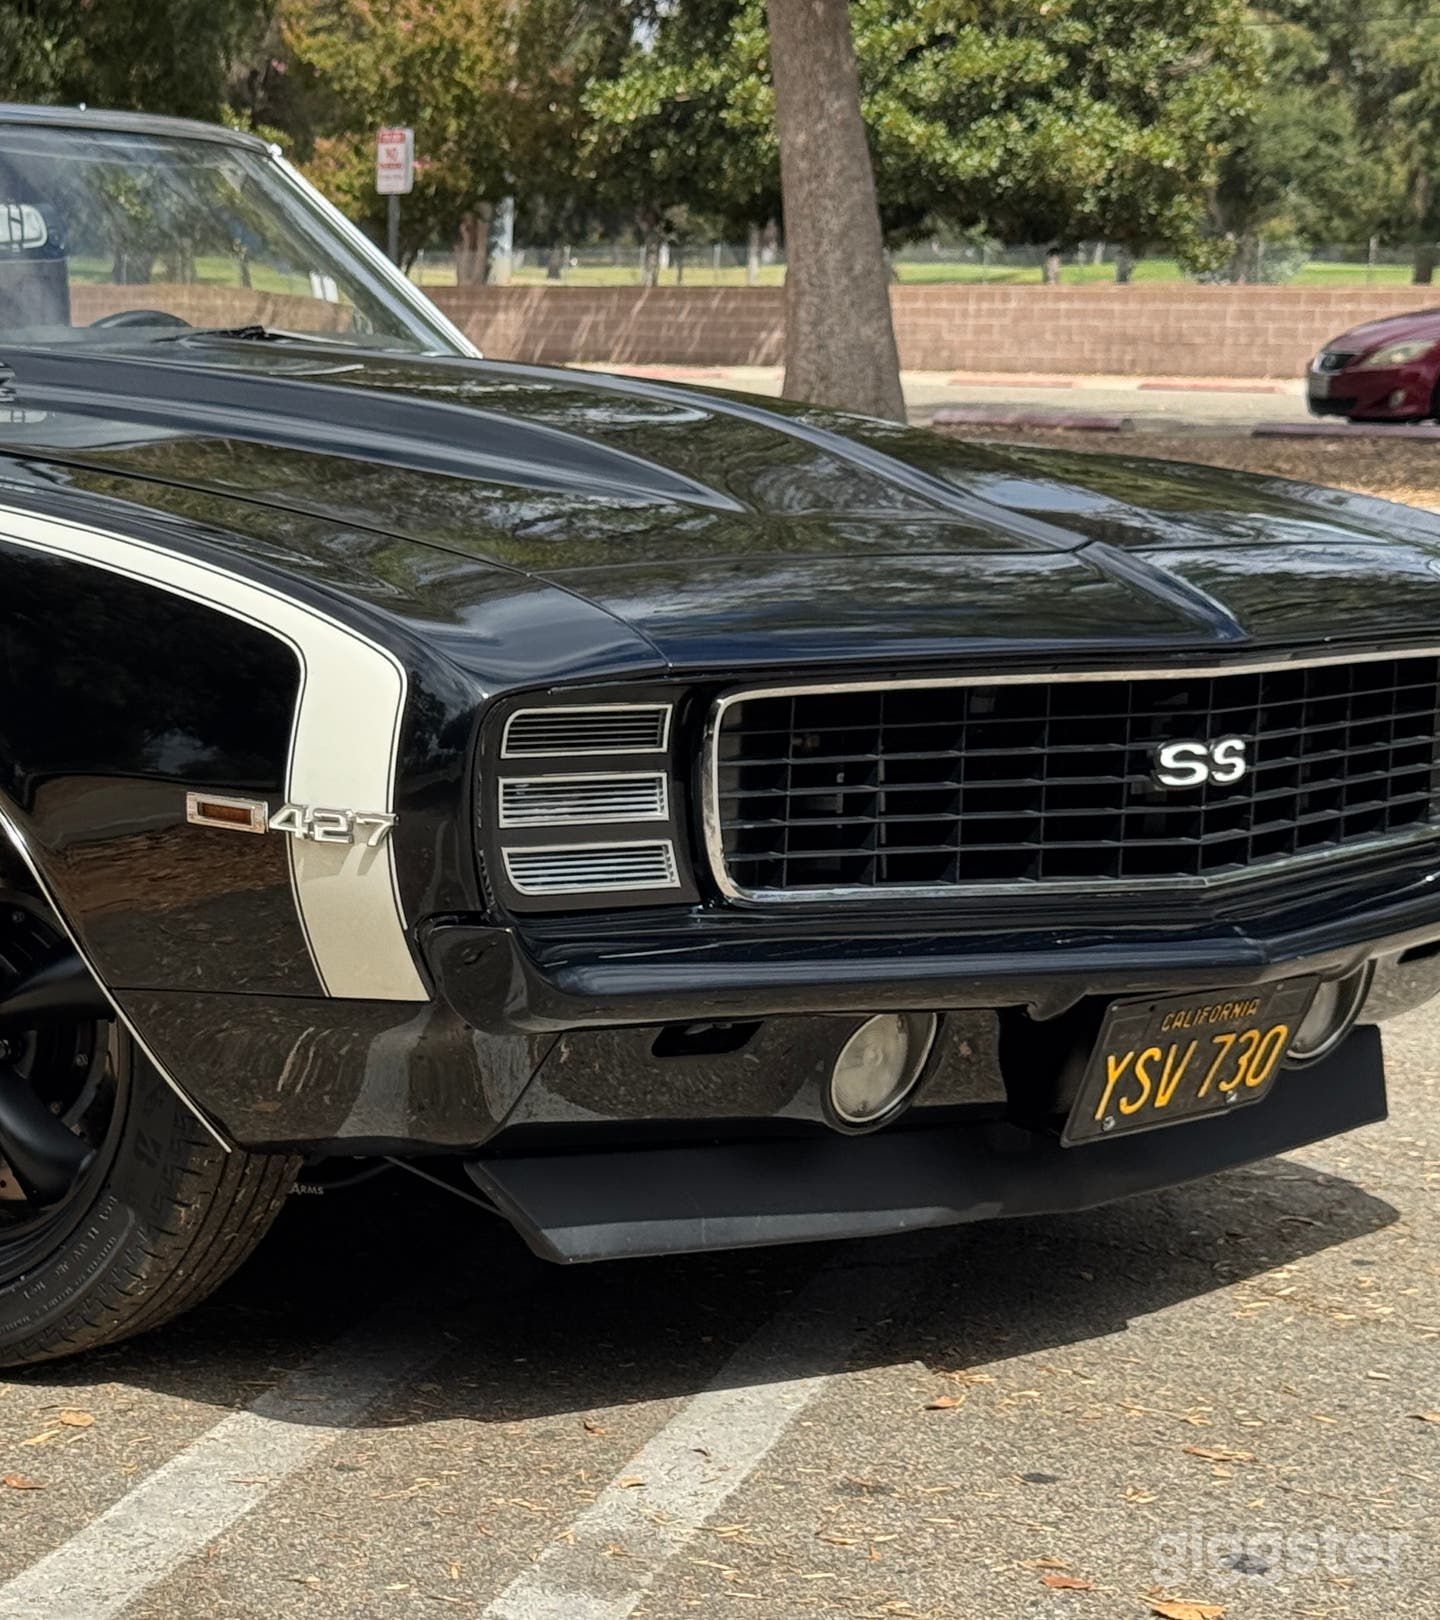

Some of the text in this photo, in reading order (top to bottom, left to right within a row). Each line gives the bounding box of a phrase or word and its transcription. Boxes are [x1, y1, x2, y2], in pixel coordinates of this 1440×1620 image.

[1157, 738, 1246, 786] SS
[268, 802, 400, 848] 427
[1161, 997, 1261, 1032] CALIFORNIA
[1094, 1024, 1289, 1120] YSV 730
